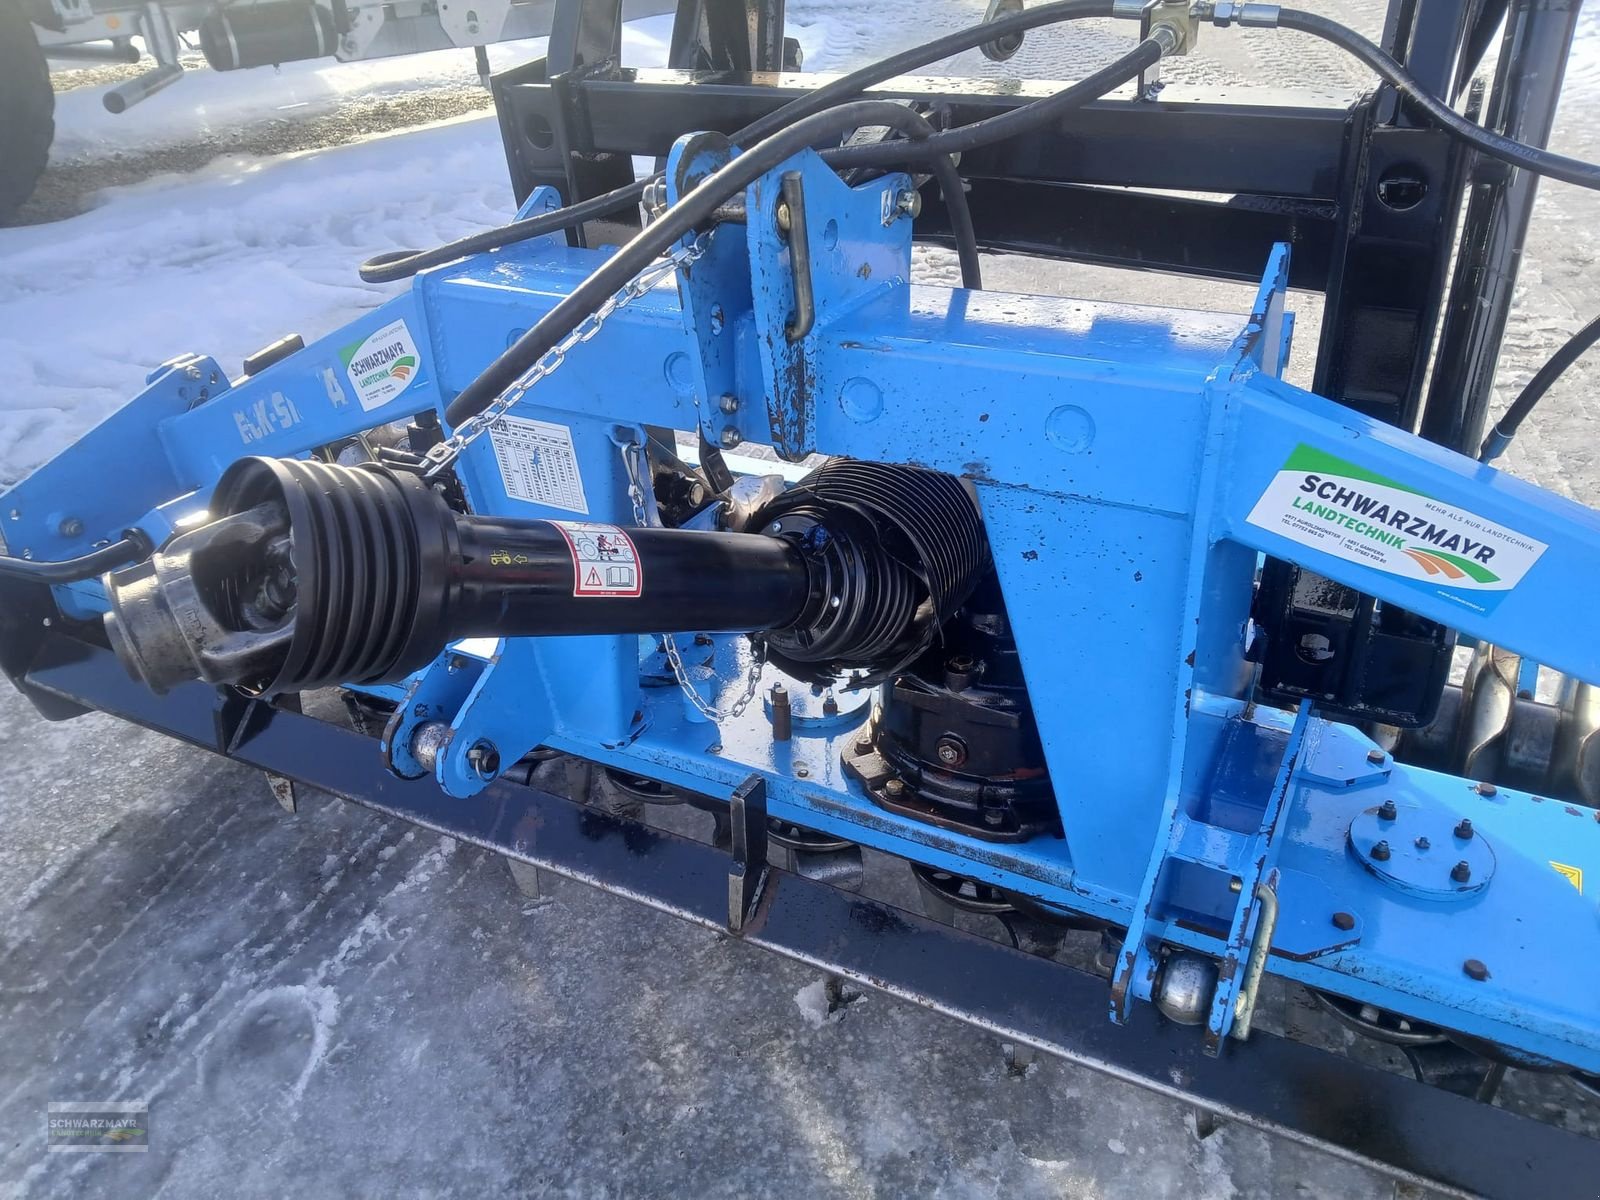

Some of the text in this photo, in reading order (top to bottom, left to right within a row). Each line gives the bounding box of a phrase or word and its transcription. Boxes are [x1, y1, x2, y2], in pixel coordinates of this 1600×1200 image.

[350, 341, 406, 377] SCHWARZMAYR
[358, 368, 391, 388] LANDTECHNIK
[1291, 495, 1407, 549] LANDTECHNIK
[1299, 474, 1497, 564] SCHWARZMAYR
[1425, 503, 1535, 552] MEHR ALS NUR LANDTECHNIK.
